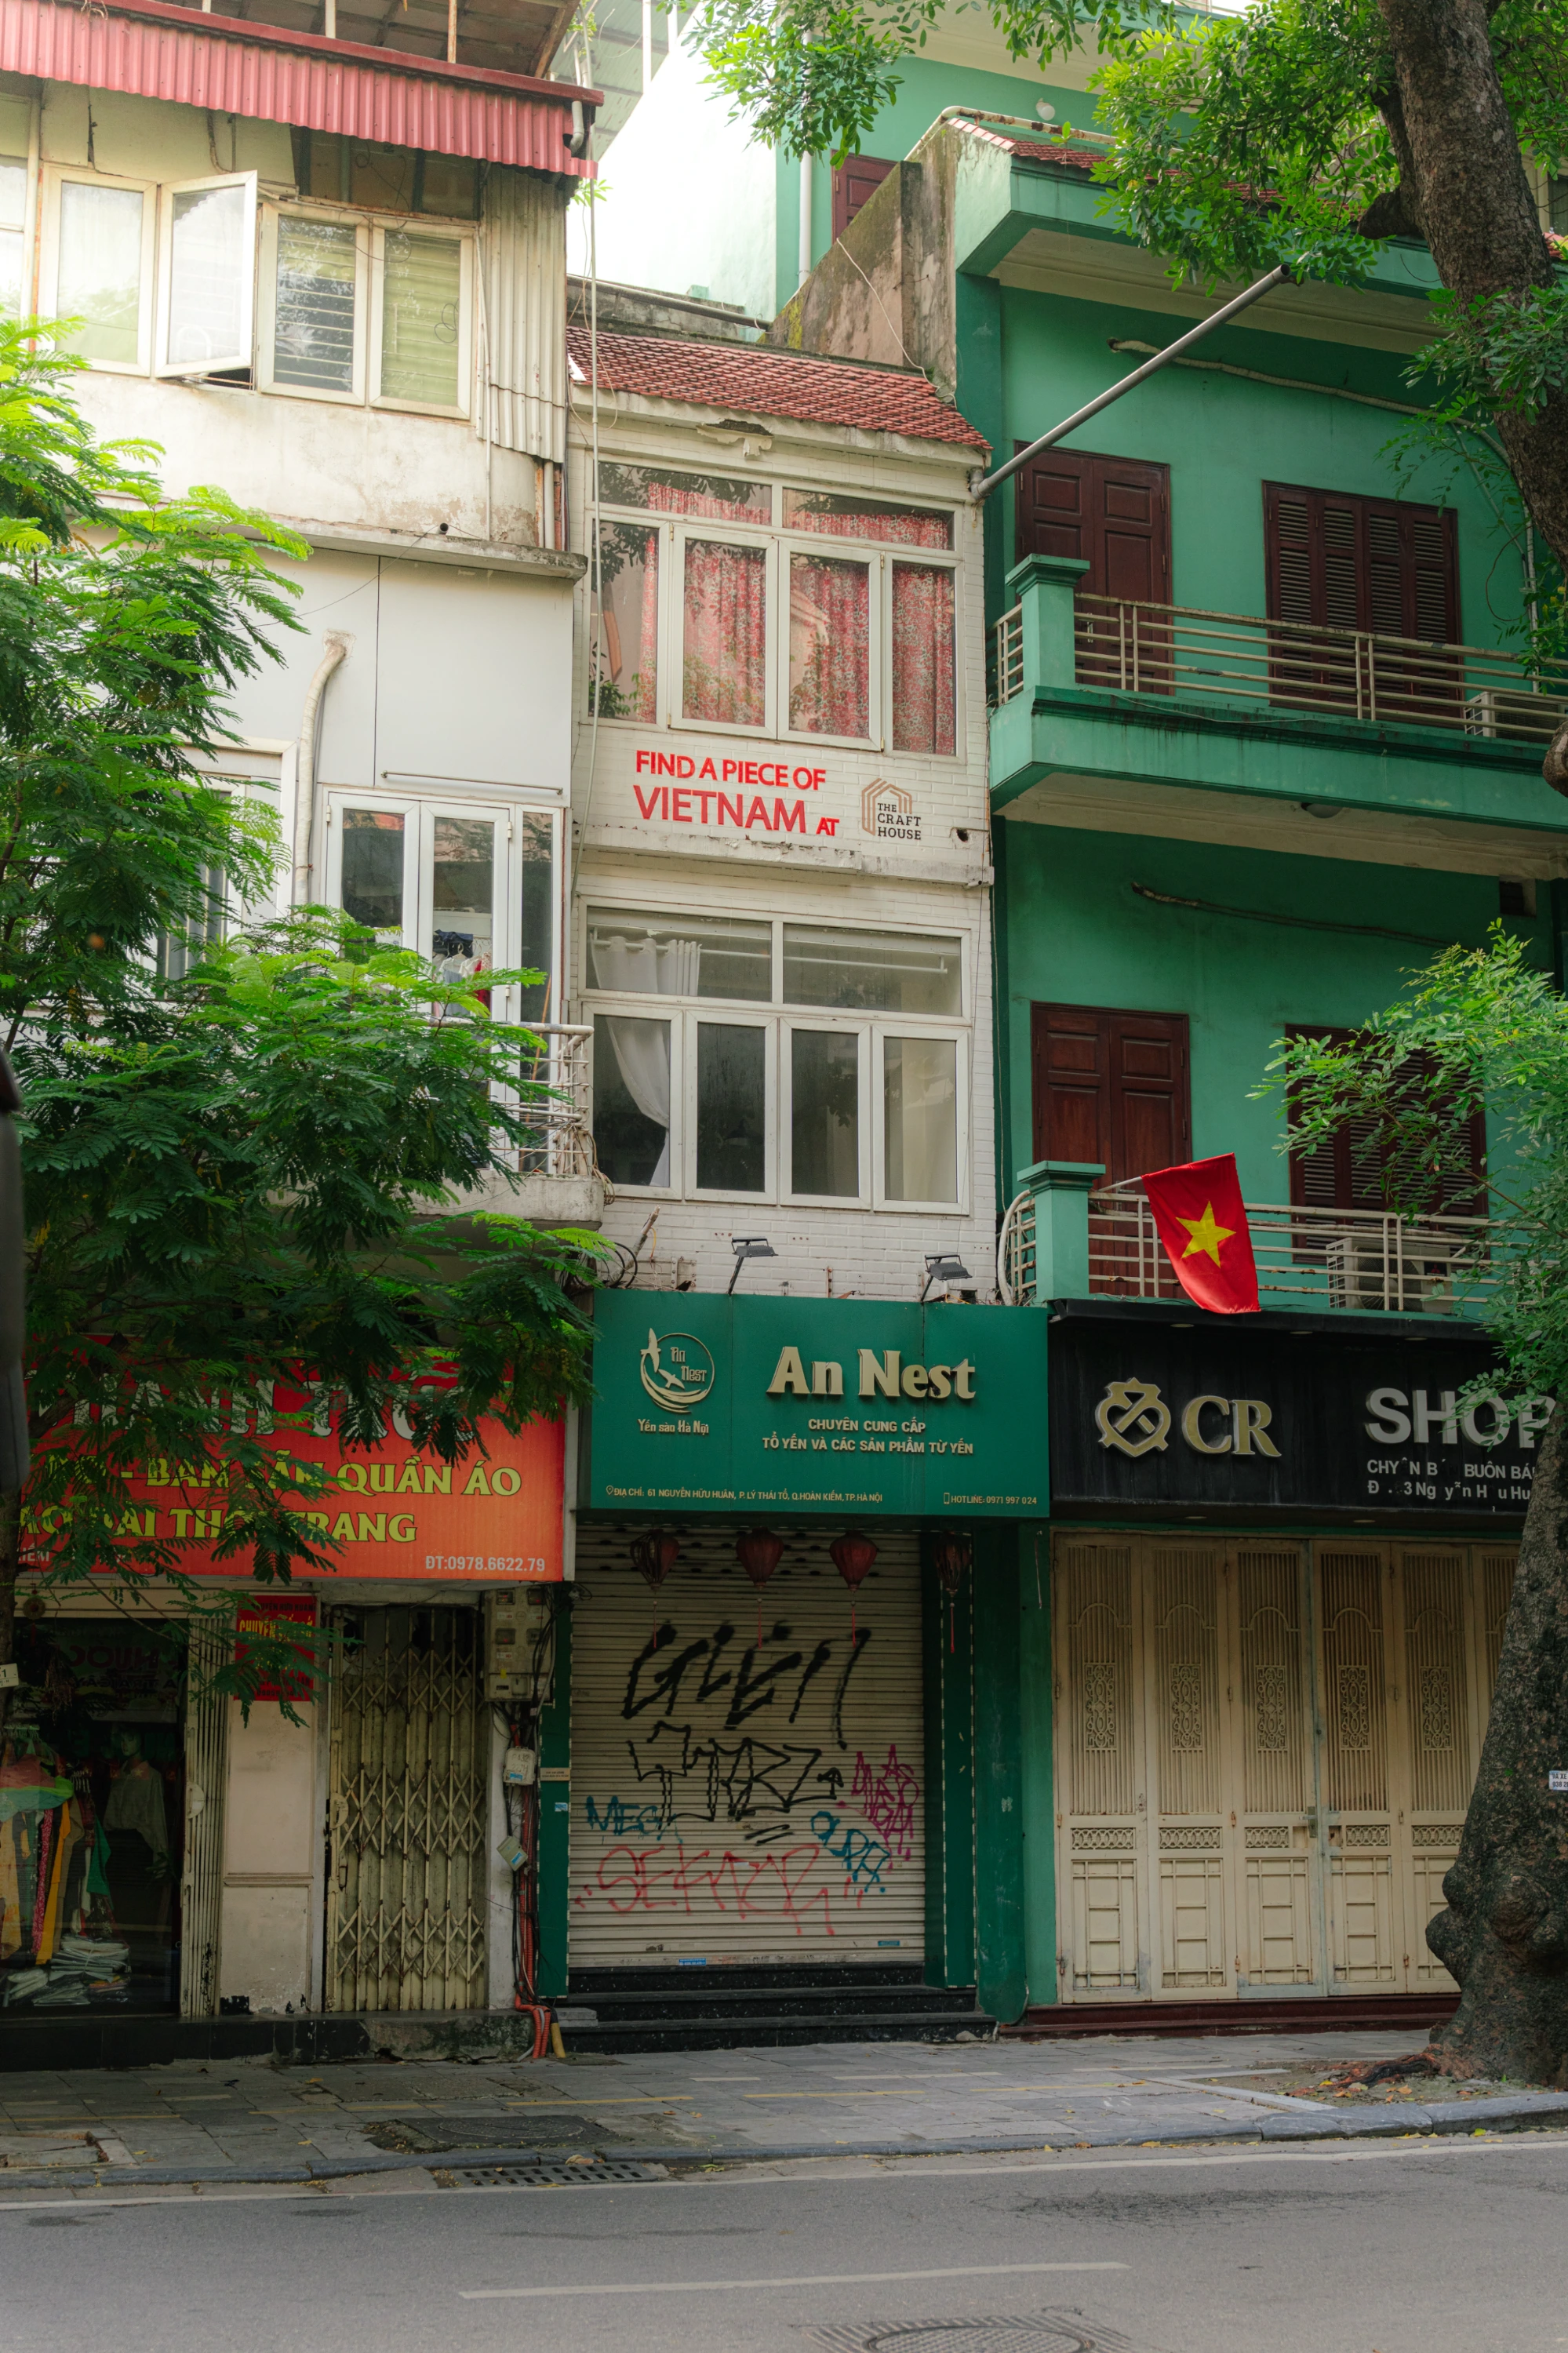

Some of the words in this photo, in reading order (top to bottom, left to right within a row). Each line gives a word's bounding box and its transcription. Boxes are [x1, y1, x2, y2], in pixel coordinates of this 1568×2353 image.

[635, 750, 696, 779] FIND
[699, 757, 717, 780] A
[722, 758, 788, 787] PIECE
[792, 766, 827, 791] OF
[633, 784, 806, 834] VIETNAM
[816, 816, 840, 837] AT
[877, 802, 897, 813] THE
[877, 813, 922, 827] CRAFT
[878, 826, 922, 841] HOUSE
[766, 1345, 844, 1395] An
[857, 1348, 977, 1400] Nest
[637, 1418, 657, 1432] Yến
[659, 1422, 675, 1433] sào
[678, 1420, 691, 1433] Hà
[693, 1420, 709, 1435] Nội
[808, 1417, 859, 1431] CHUYÊN
[863, 1420, 897, 1433] CUNG
[901, 1417, 926, 1434] CẤP
[1181, 1395, 1282, 1458] CR
[1365, 1387, 1557, 1449] SHOP
[762, 1431, 780, 1449] TỔ
[782, 1433, 807, 1450] YẾN
[811, 1436, 828, 1450] VÀ
[831, 1436, 856, 1451] CÁC
[860, 1437, 885, 1452] SẢN
[889, 1437, 925, 1453] PHẨM
[929, 1439, 947, 1454] TỪ
[949, 1438, 974, 1454] YẾN
[337, 1455, 453, 1497] QUẦN
[461, 1460, 522, 1497] ÁO
[1464, 1460, 1506, 1479] BUÔN
[1511, 1463, 1536, 1480] BÁ
[647, 1489, 656, 1497] 61
[658, 1487, 691, 1498] NGUYỄN
[693, 1488, 710, 1499] HỮU
[712, 1489, 737, 1500] HUÂN,
[747, 1489, 756, 1500] LÝ
[758, 1489, 776, 1500] THÁI
[824, 1489, 845, 1502] KIẾM,
[869, 1492, 882, 1504] NỘI
[951, 1495, 985, 1504] HOTLINE:
[986, 1496, 1003, 1504] 0971
[1006, 1496, 1020, 1504] 997
[425, 1555, 545, 1572] ĐT:0978.6622.79
